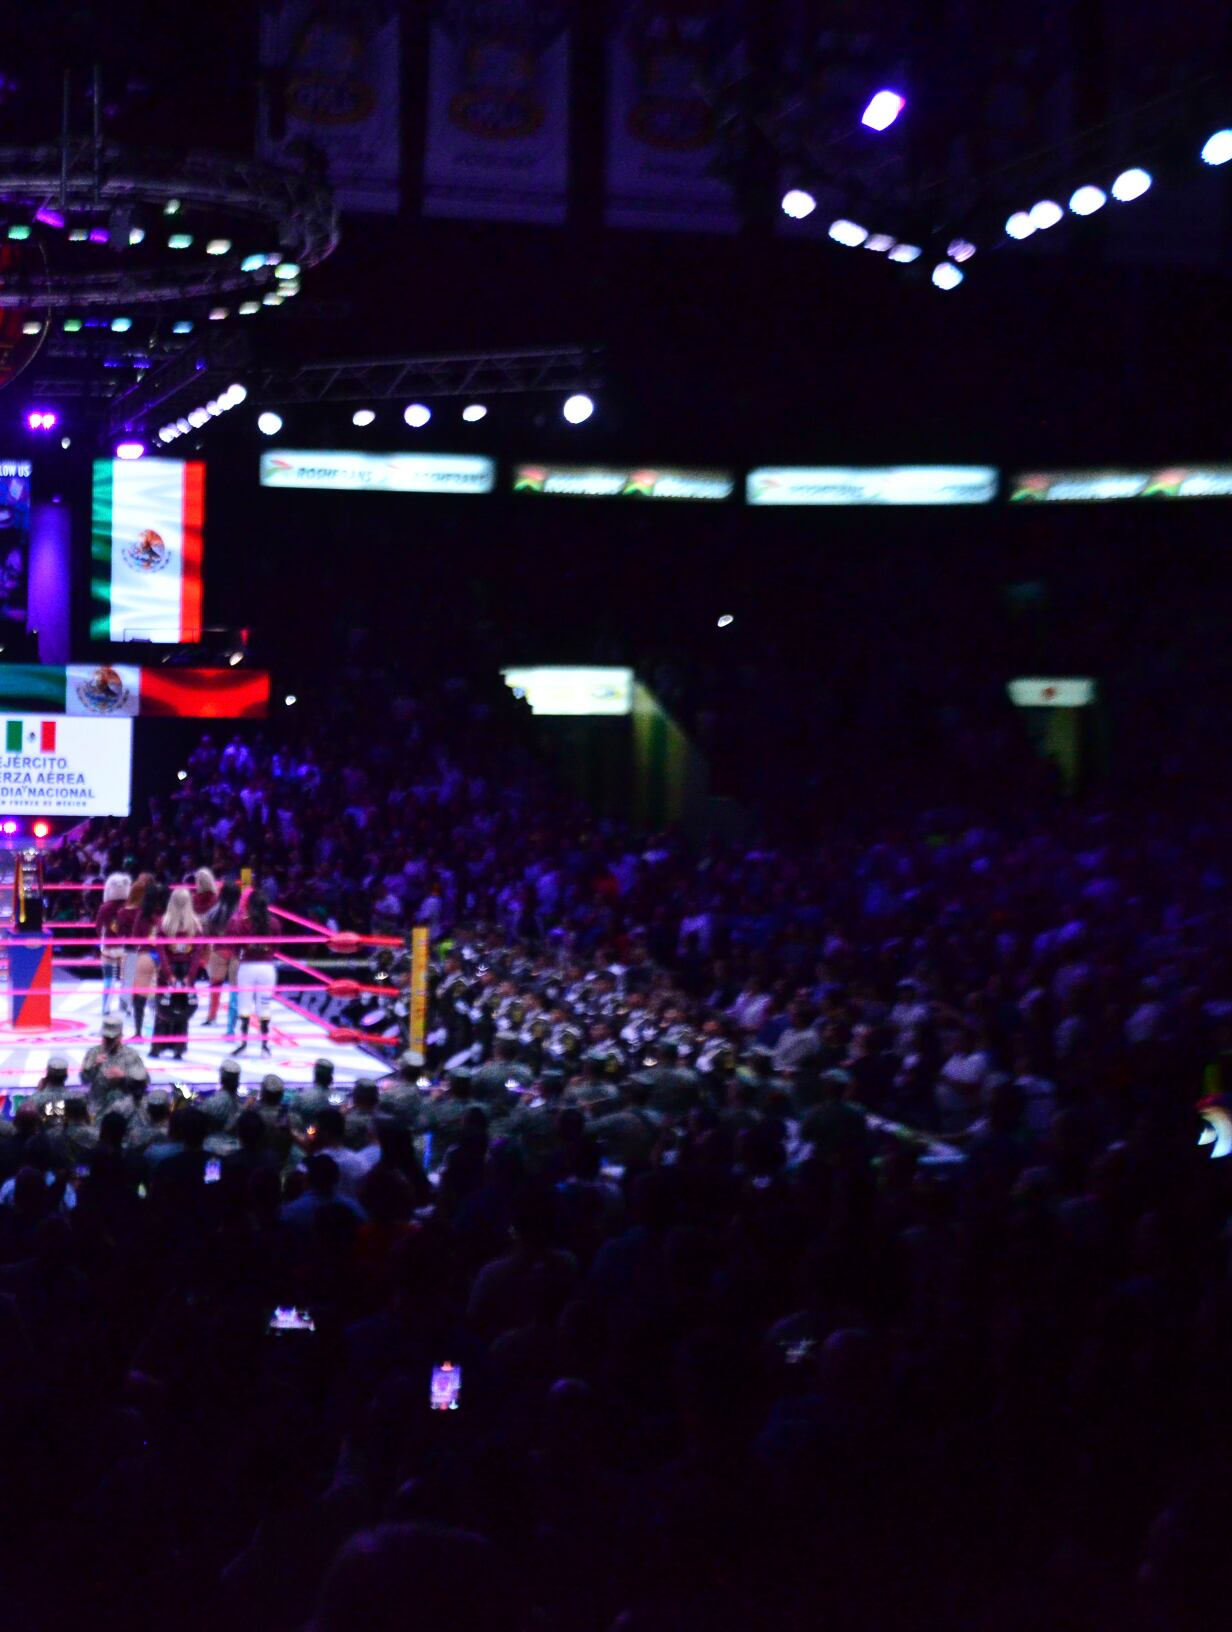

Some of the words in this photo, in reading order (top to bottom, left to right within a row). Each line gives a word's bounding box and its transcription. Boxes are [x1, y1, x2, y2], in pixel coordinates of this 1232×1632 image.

[17, 462, 31, 478] US
[36, 769, 85, 785] AÉREA
[27, 786, 96, 799] NACIONAL
